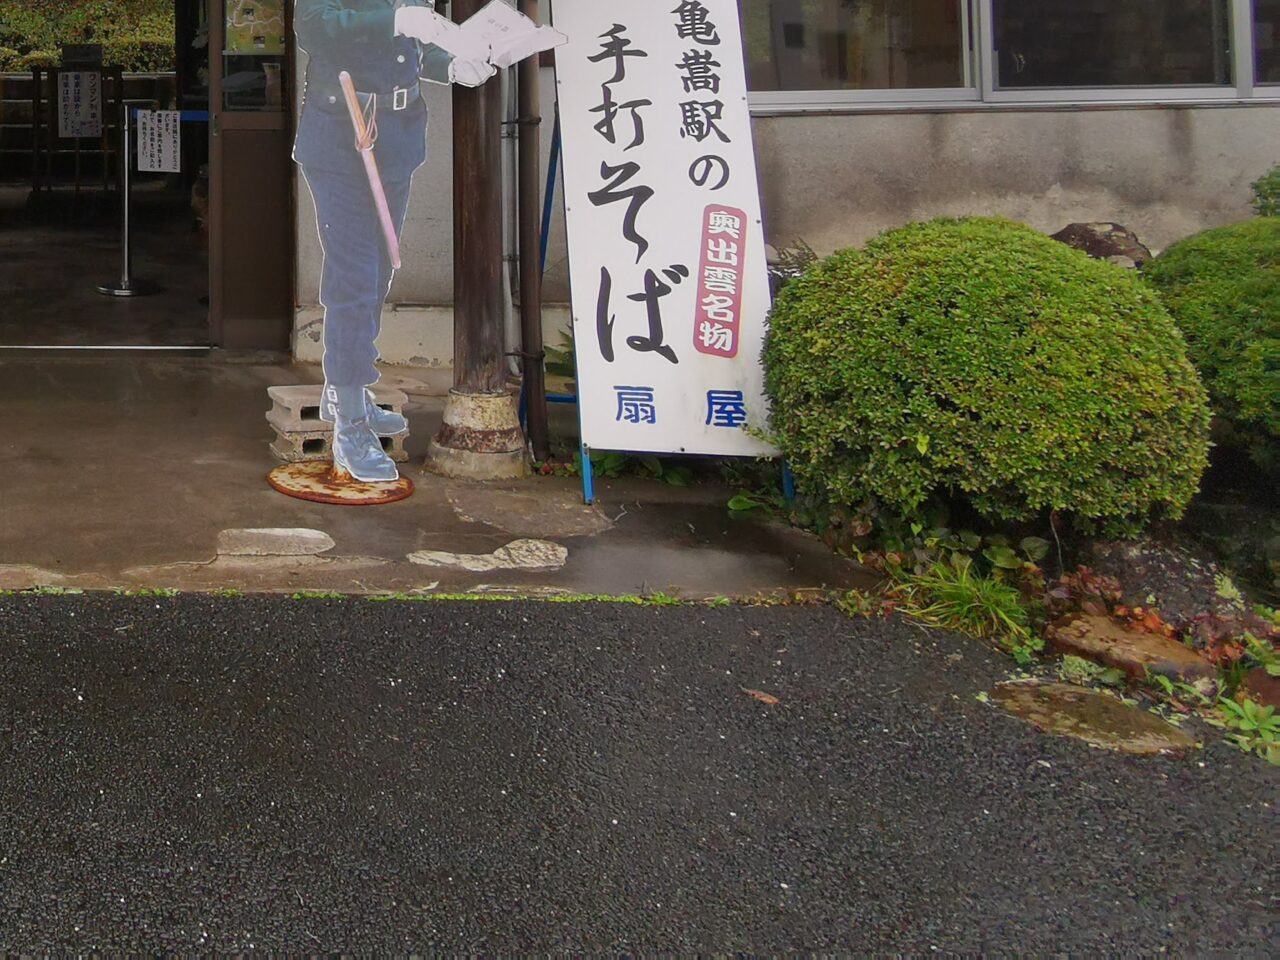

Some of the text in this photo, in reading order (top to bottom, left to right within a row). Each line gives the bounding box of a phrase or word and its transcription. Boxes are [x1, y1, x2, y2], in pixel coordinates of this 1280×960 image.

[669, 0, 732, 191] 亀嵩駅の
[587, 23, 689, 365] 手打そば
[699, 210, 741, 352] 奥出雲名物
